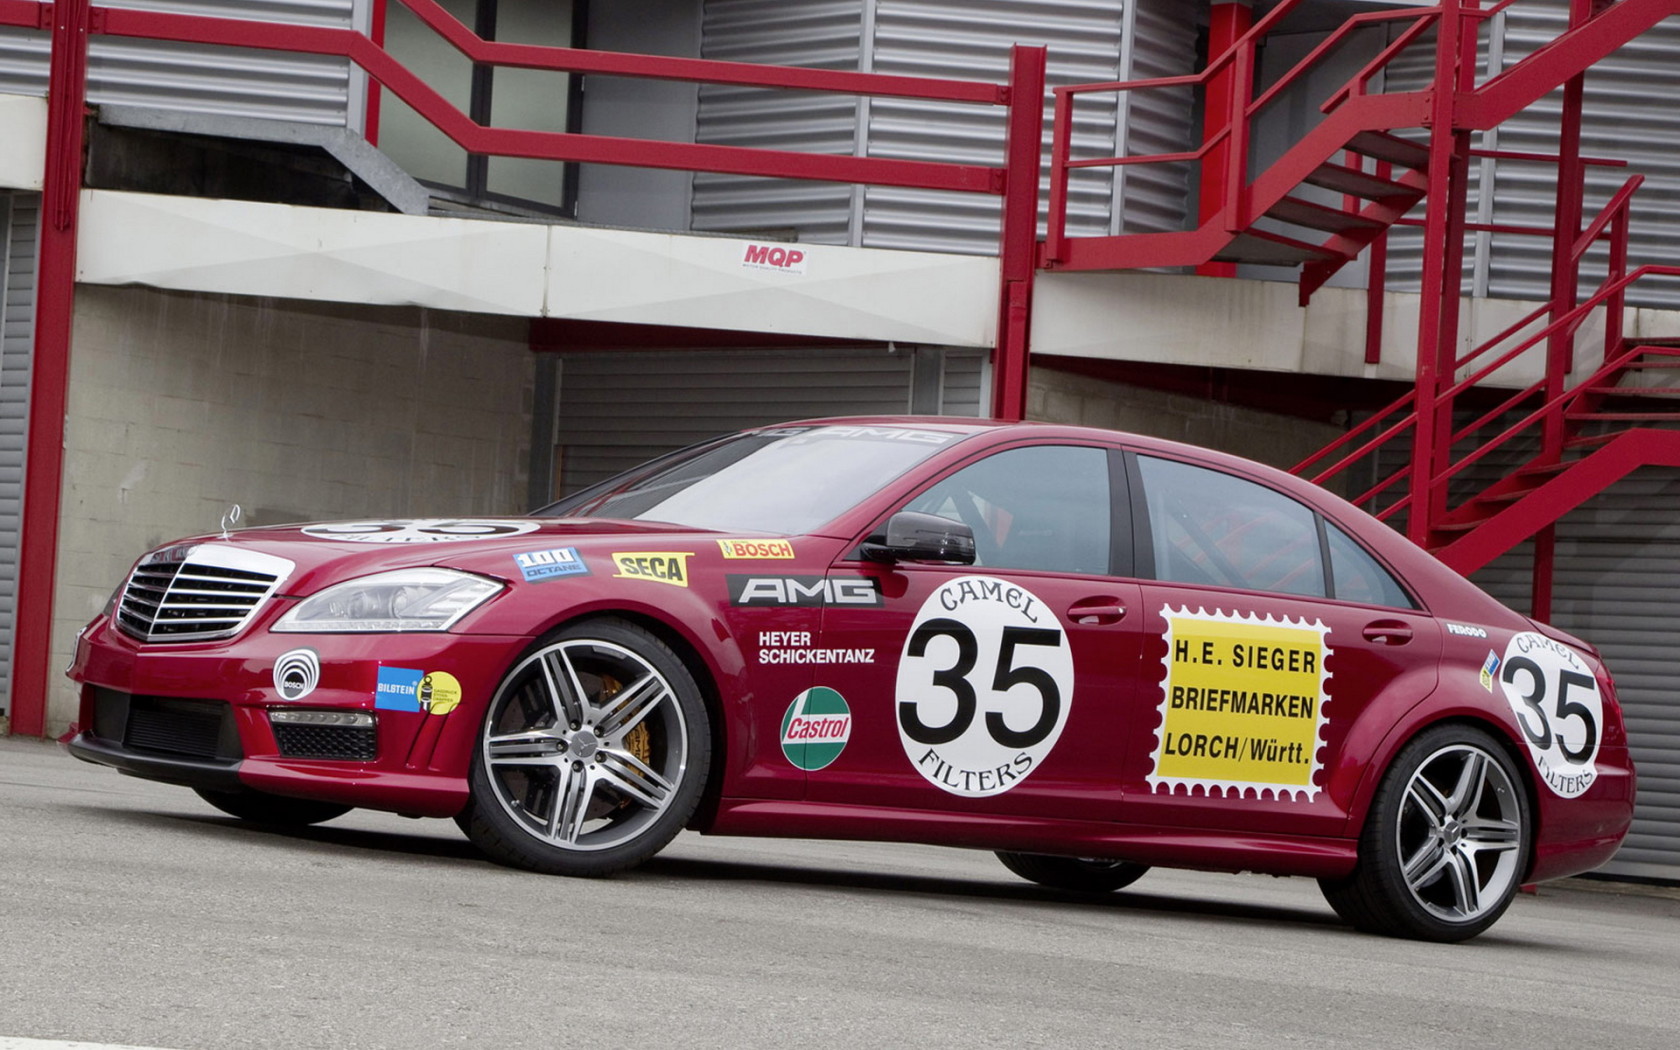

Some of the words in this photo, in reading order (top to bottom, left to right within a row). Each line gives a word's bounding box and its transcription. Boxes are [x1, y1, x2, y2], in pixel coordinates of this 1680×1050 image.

[744, 244, 804, 267] MQP
[517, 548, 576, 568] 100
[733, 543, 792, 557] BOSCH
[526, 563, 582, 578] OCTANE
[620, 557, 684, 581] SECA
[738, 578, 877, 604] AMG
[940, 579, 1038, 623] CAMEL
[758, 631, 811, 646] HEYER
[1446, 623, 1487, 638] FERODO
[758, 648, 875, 664] SCHICKENTANZ
[1175, 639, 1223, 666] H.E.
[1232, 643, 1316, 674] SIEGER
[1516, 635, 1580, 670] CAMEL
[377, 682, 415, 695] BILSTEIN
[899, 617, 1062, 749] 35
[1171, 685, 1314, 720] BRIEFMARKEN
[1502, 655, 1598, 766] 35
[787, 716, 850, 739] Castrol
[1164, 732, 1310, 765] LORCH/Württ.
[918, 748, 1033, 791] FILTERS
[1537, 754, 1595, 795] FILTERS
